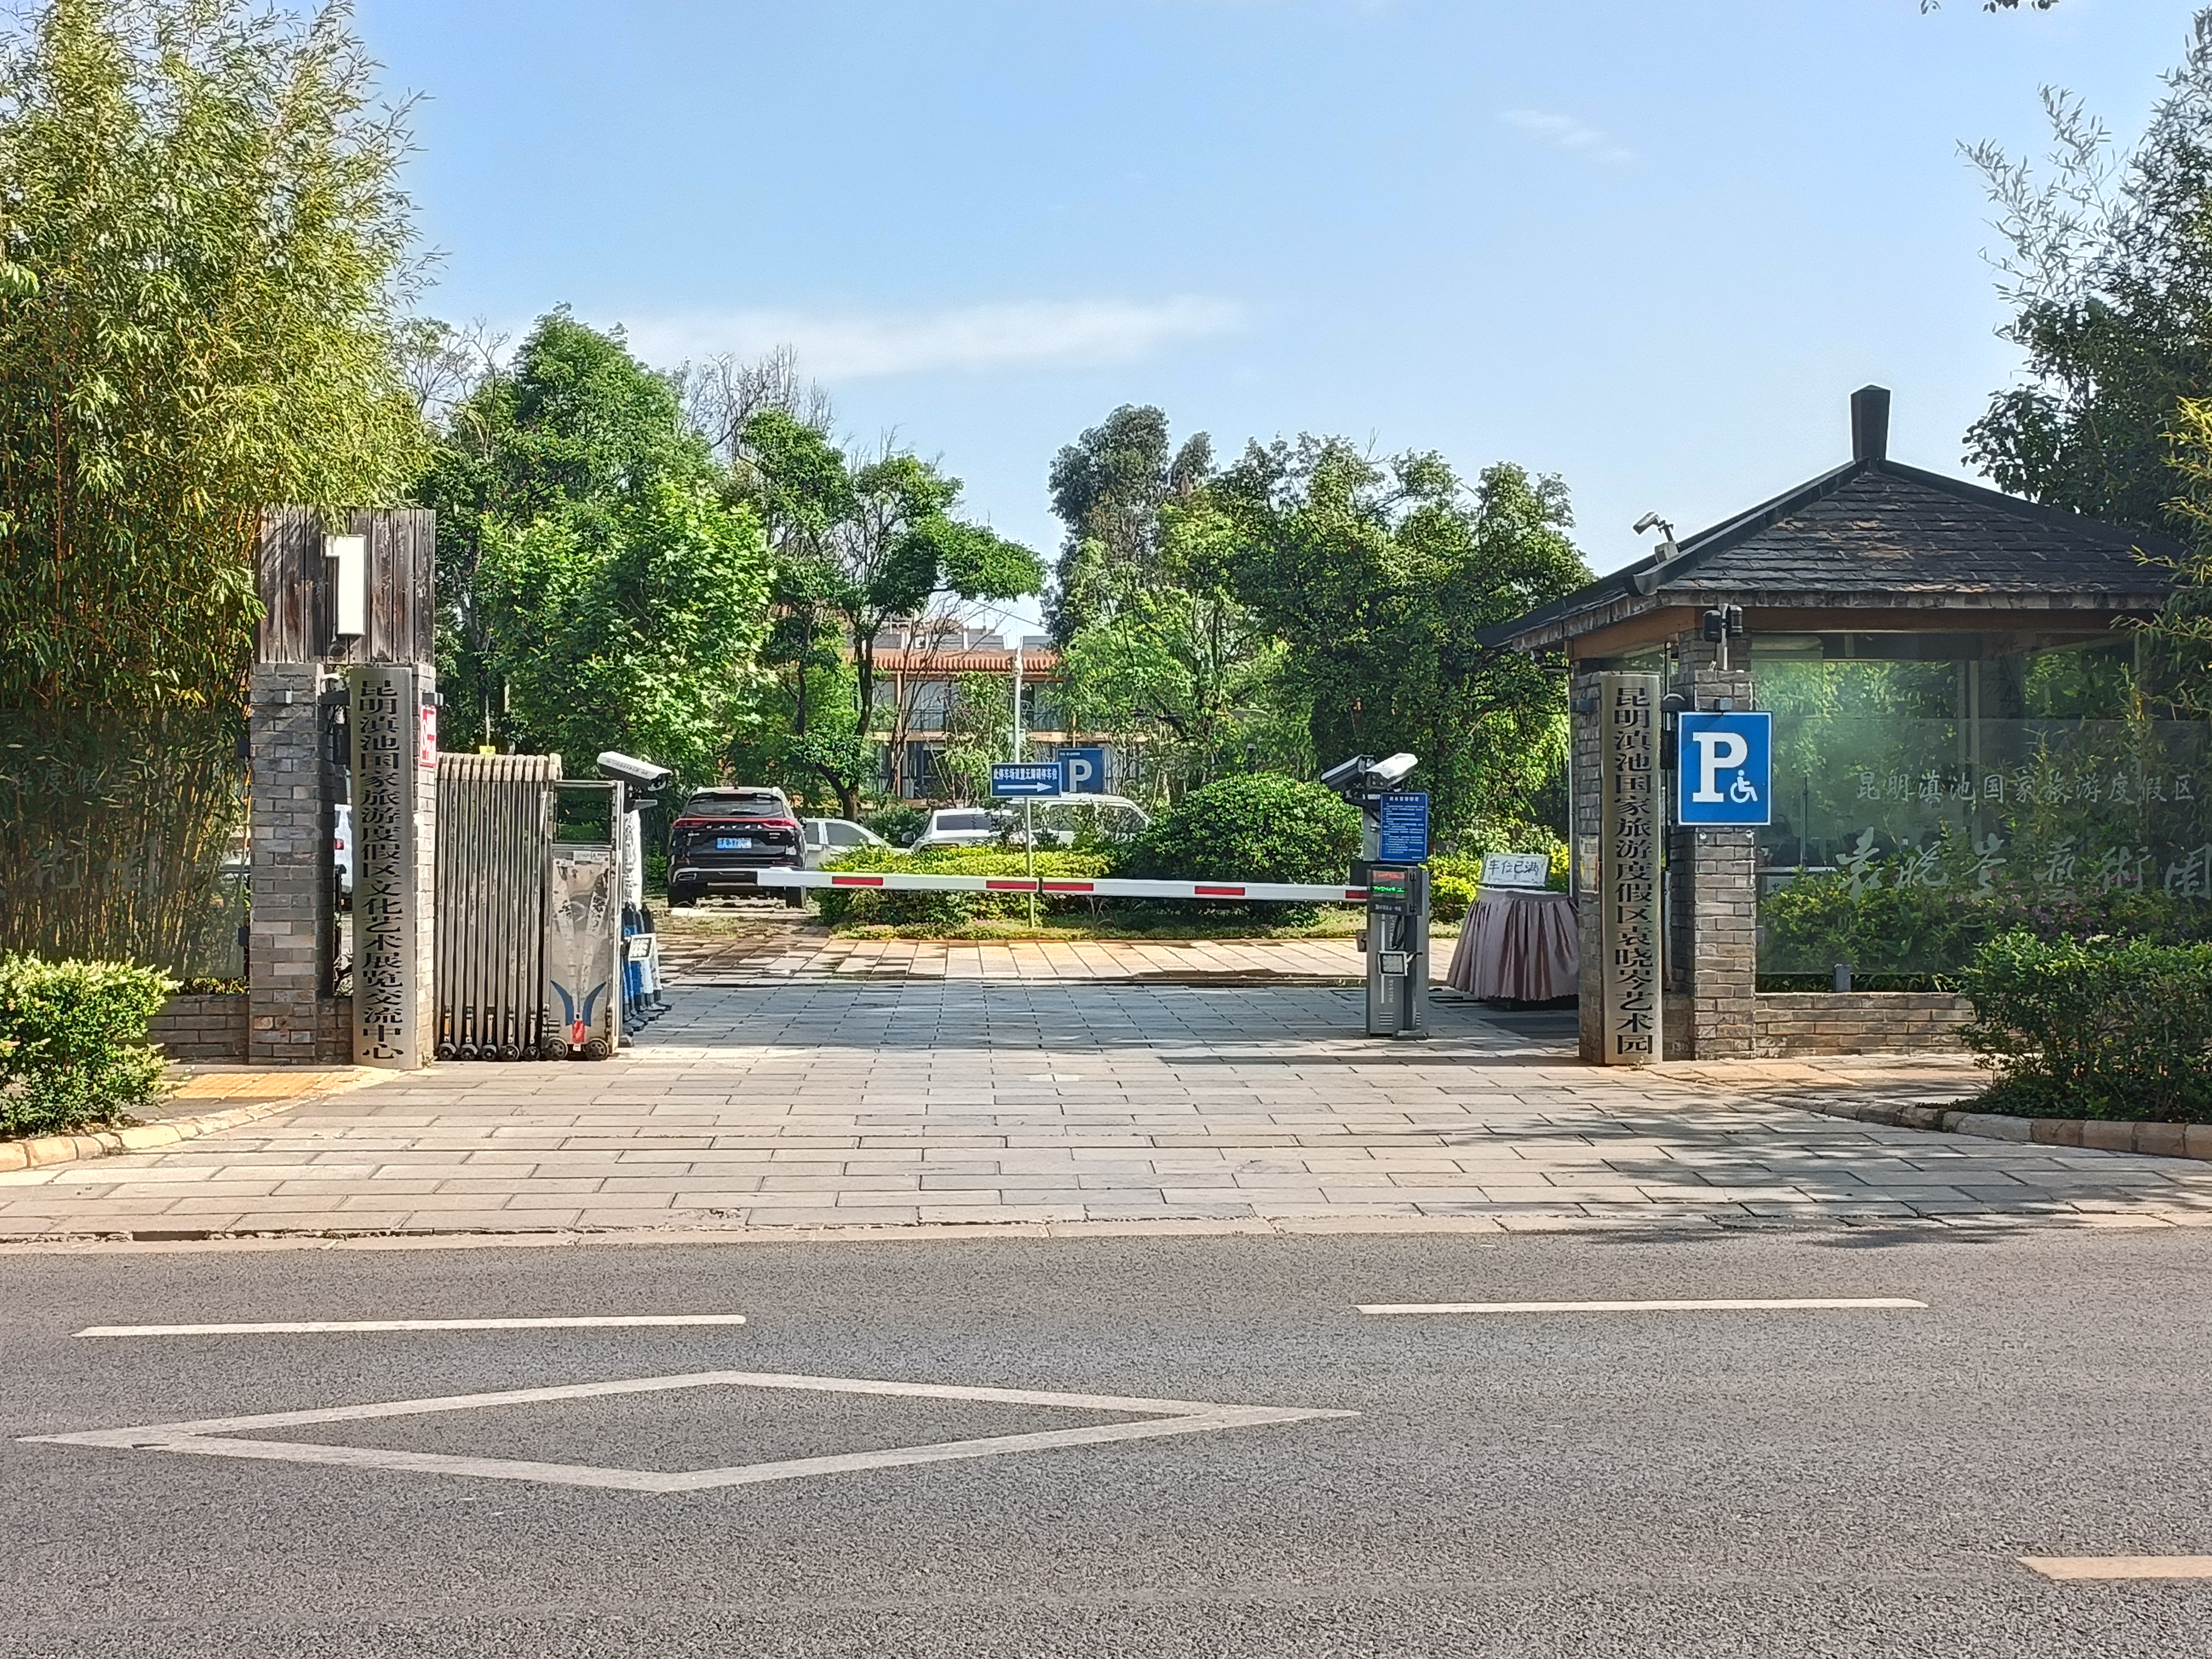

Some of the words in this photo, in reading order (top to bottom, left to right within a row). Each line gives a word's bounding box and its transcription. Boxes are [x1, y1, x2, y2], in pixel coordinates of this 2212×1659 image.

[326, 534, 366, 635] 1
[1070, 759, 1092, 792] P
[1692, 732, 1747, 802] P
[1856, 767, 2195, 805] 昆明滇池国家旅游度假区
[359, 680, 404, 1060] 昆明滇池国家旅游度假区文化艺术展览交流中心
[1488, 859, 1539, 875] 车位已满
[1614, 687, 1653, 1054] 昆明滇池国家旅游度假区袁晓岑艺术园
